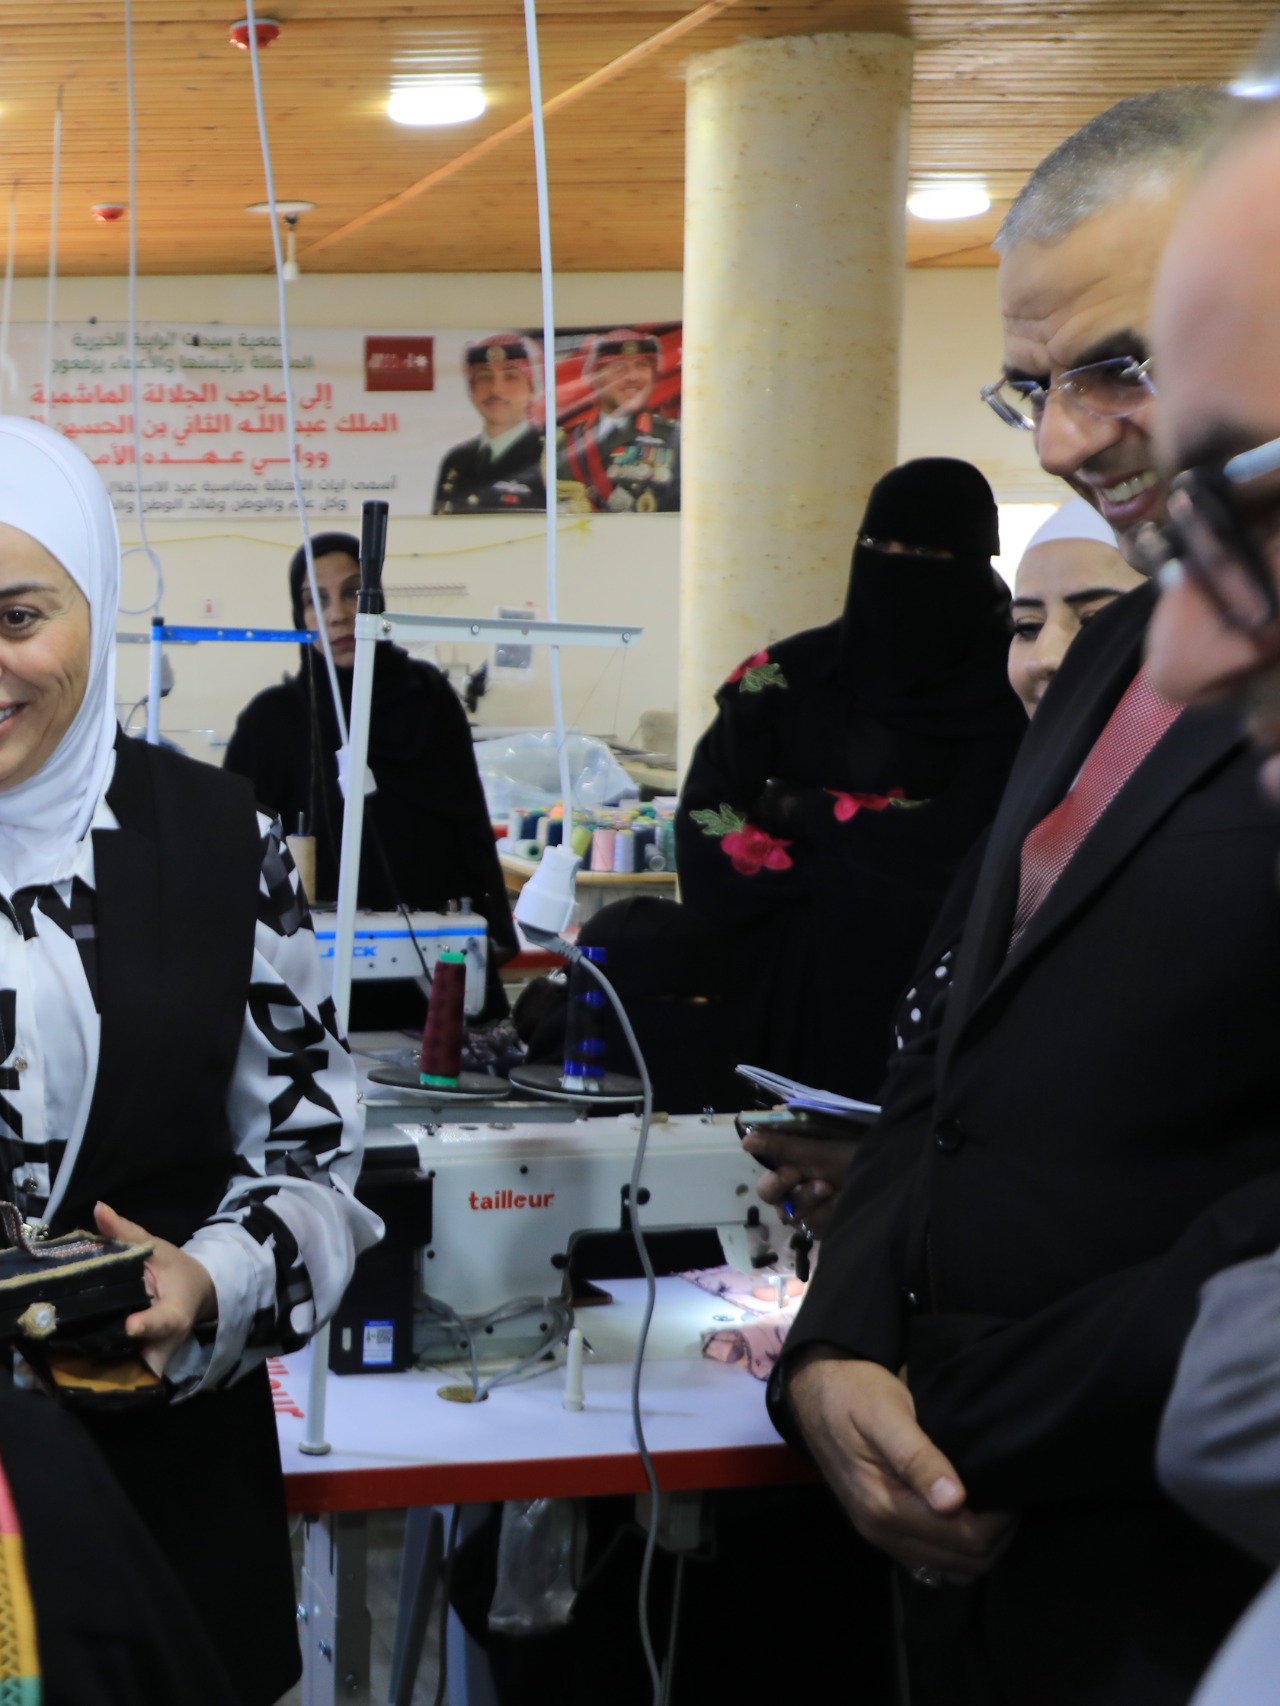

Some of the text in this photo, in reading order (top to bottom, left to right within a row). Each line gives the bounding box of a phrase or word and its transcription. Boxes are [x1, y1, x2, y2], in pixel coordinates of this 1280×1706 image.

[238, 331, 287, 350] معية
[30, 383, 333, 409] إلى صاحب الجلالة الهاشمية
[141, 419, 167, 438] بن
[173, 412, 231, 446] الثاني
[238, 412, 286, 433] الله
[293, 419, 327, 437] عبد
[335, 412, 399, 433] الملك
[320, 945, 377, 958] JCK
[468, 1189, 555, 1211] tailleur
